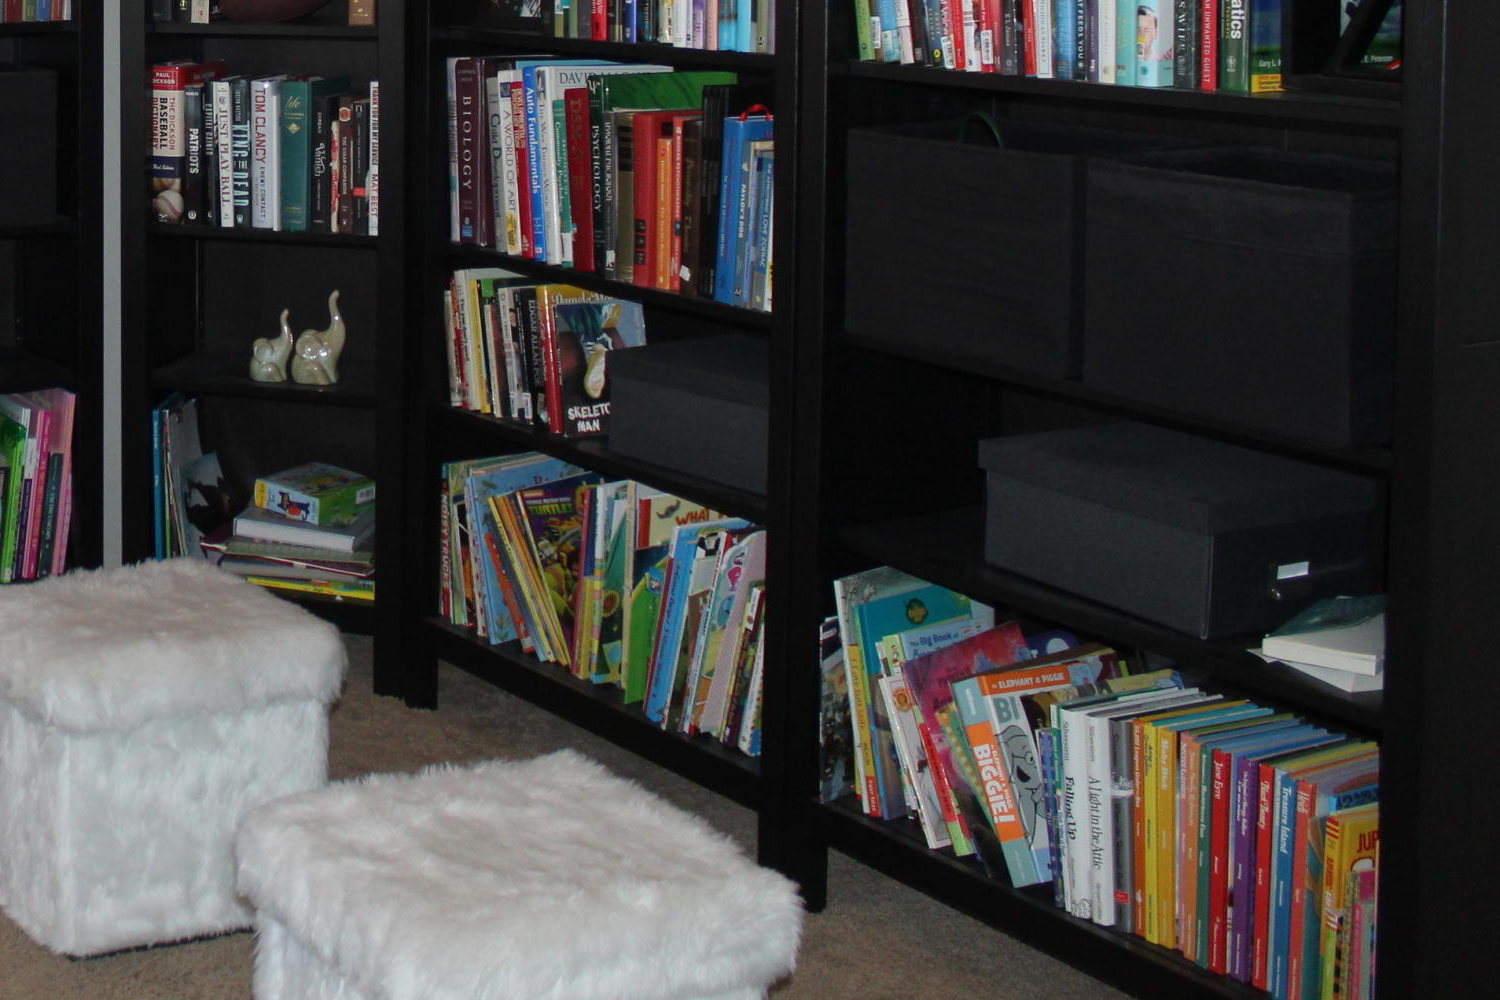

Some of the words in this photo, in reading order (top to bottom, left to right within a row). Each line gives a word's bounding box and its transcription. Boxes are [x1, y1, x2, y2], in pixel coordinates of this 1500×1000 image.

[1203, 57, 1211, 83] GUEST
[255, 89, 267, 113] TOM
[526, 87, 534, 113] Auto
[160, 97, 168, 150] BASEBALL
[204, 103, 213, 129] CAPITAL
[218, 108, 230, 138] JUST
[504, 110, 512, 120] A
[232, 124, 250, 157] KING
[255, 116, 267, 164] CLANCY
[490, 114, 501, 144] Child
[188, 128, 200, 174] PATRIOTS
[462, 96, 471, 190] BIOLOGY
[504, 123, 515, 166] WORLD
[528, 117, 540, 194] Fundamentals
[219, 144, 229, 171] PLAY
[592, 125, 601, 212] PSYCHOLOGY
[233, 172, 250, 206] DEAD
[492, 147, 501, 218] Development
[506, 170, 516, 185] OF
[220, 176, 231, 207] BALL
[507, 190, 516, 211] ART
[738, 183, 746, 219] PAVLOV'S
[567, 403, 611, 421] SKELETO
[577, 420, 600, 432] MAN
[440, 494, 450, 535] NOISY
[528, 503, 574, 515] TURTLES
[441, 538, 451, 588] TRUCKS
[920, 635, 932, 646] Big
[932, 633, 951, 643] Book
[998, 675, 1034, 690] ELEPHANT
[1042, 671, 1065, 683] PIGGIE
[1062, 721, 1070, 761] Silverstein
[1089, 776, 1100, 785] A
[1160, 765, 1169, 790] Dick
[1214, 760, 1223, 779] Jane
[973, 743, 1015, 824] BIGGIE!
[1214, 780, 1223, 799] Eyre
[1261, 781, 1270, 804] Black
[1064, 776, 1076, 819] Falling
[1086, 786, 1102, 813] Light
[1281, 786, 1292, 824] Treasure
[1297, 791, 1309, 815] Heidi
[1062, 821, 1076, 840] Up
[1090, 814, 1100, 824] in
[1257, 805, 1269, 830] Beauty
[1091, 826, 1101, 843] the
[1279, 825, 1290, 854] Island
[1091, 844, 1104, 870] Attic
